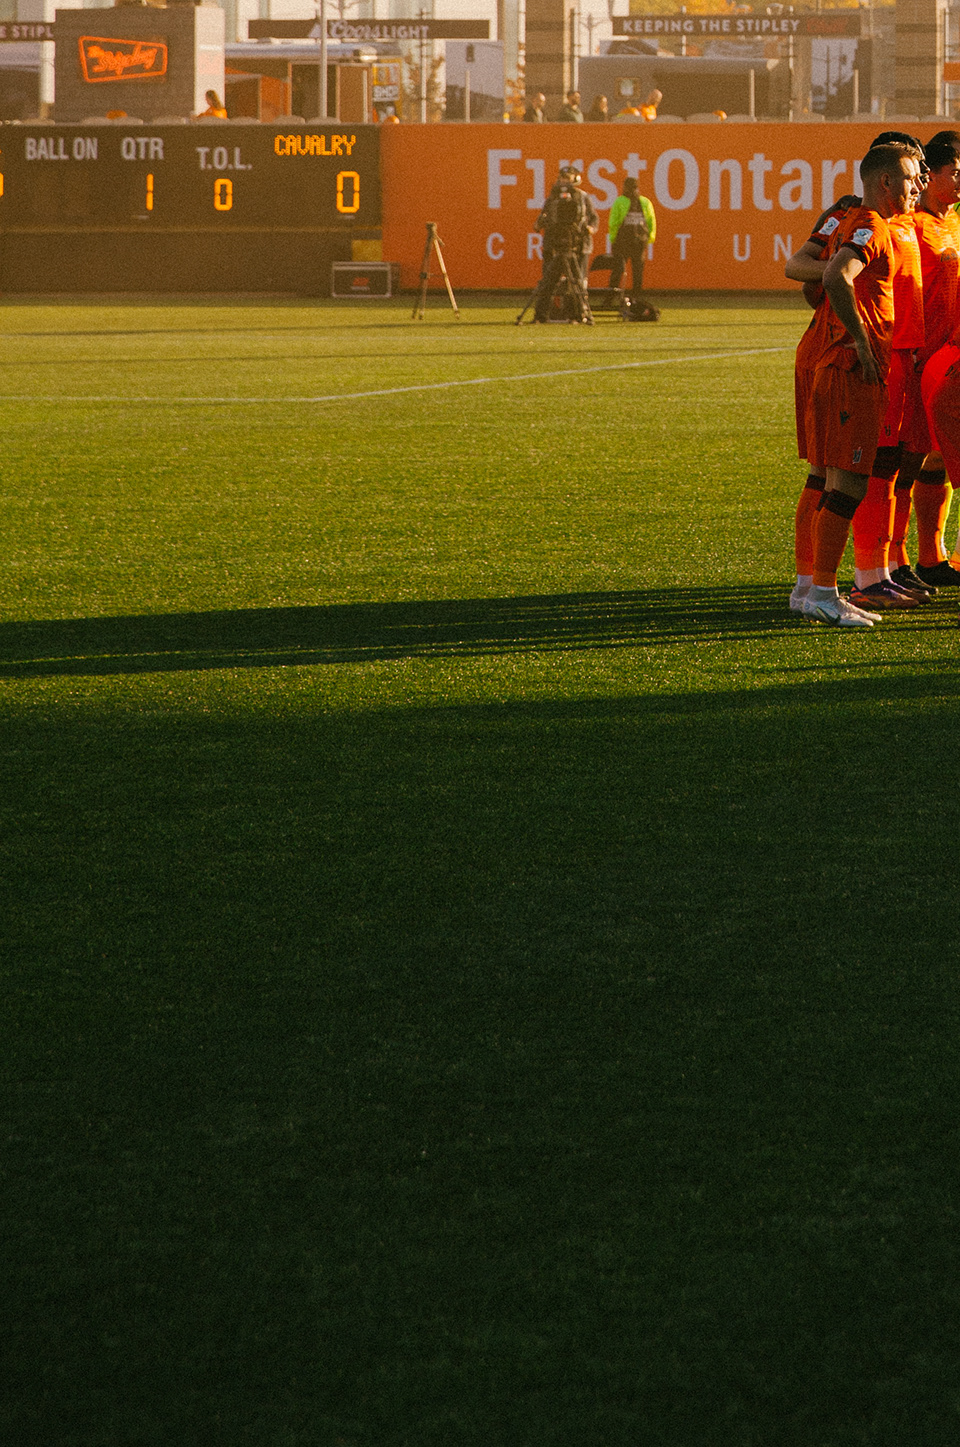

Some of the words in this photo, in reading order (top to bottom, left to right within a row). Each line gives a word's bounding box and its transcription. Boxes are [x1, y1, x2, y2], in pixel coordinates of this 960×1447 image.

[382, 25, 430, 39] LIGHT
[623, 19, 694, 32] KEEPING
[700, 19, 731, 32] THE
[736, 18, 801, 32] STIPLEY
[25, 137, 70, 160] BALL
[73, 137, 98, 160] ON
[121, 136, 165, 161] QTR
[274, 134, 356, 155] CAVALRY
[196, 146, 252, 170] T.O.L.
[146, 173, 154, 211] 1
[214, 178, 233, 211] 0
[336, 170, 360, 213] 0
